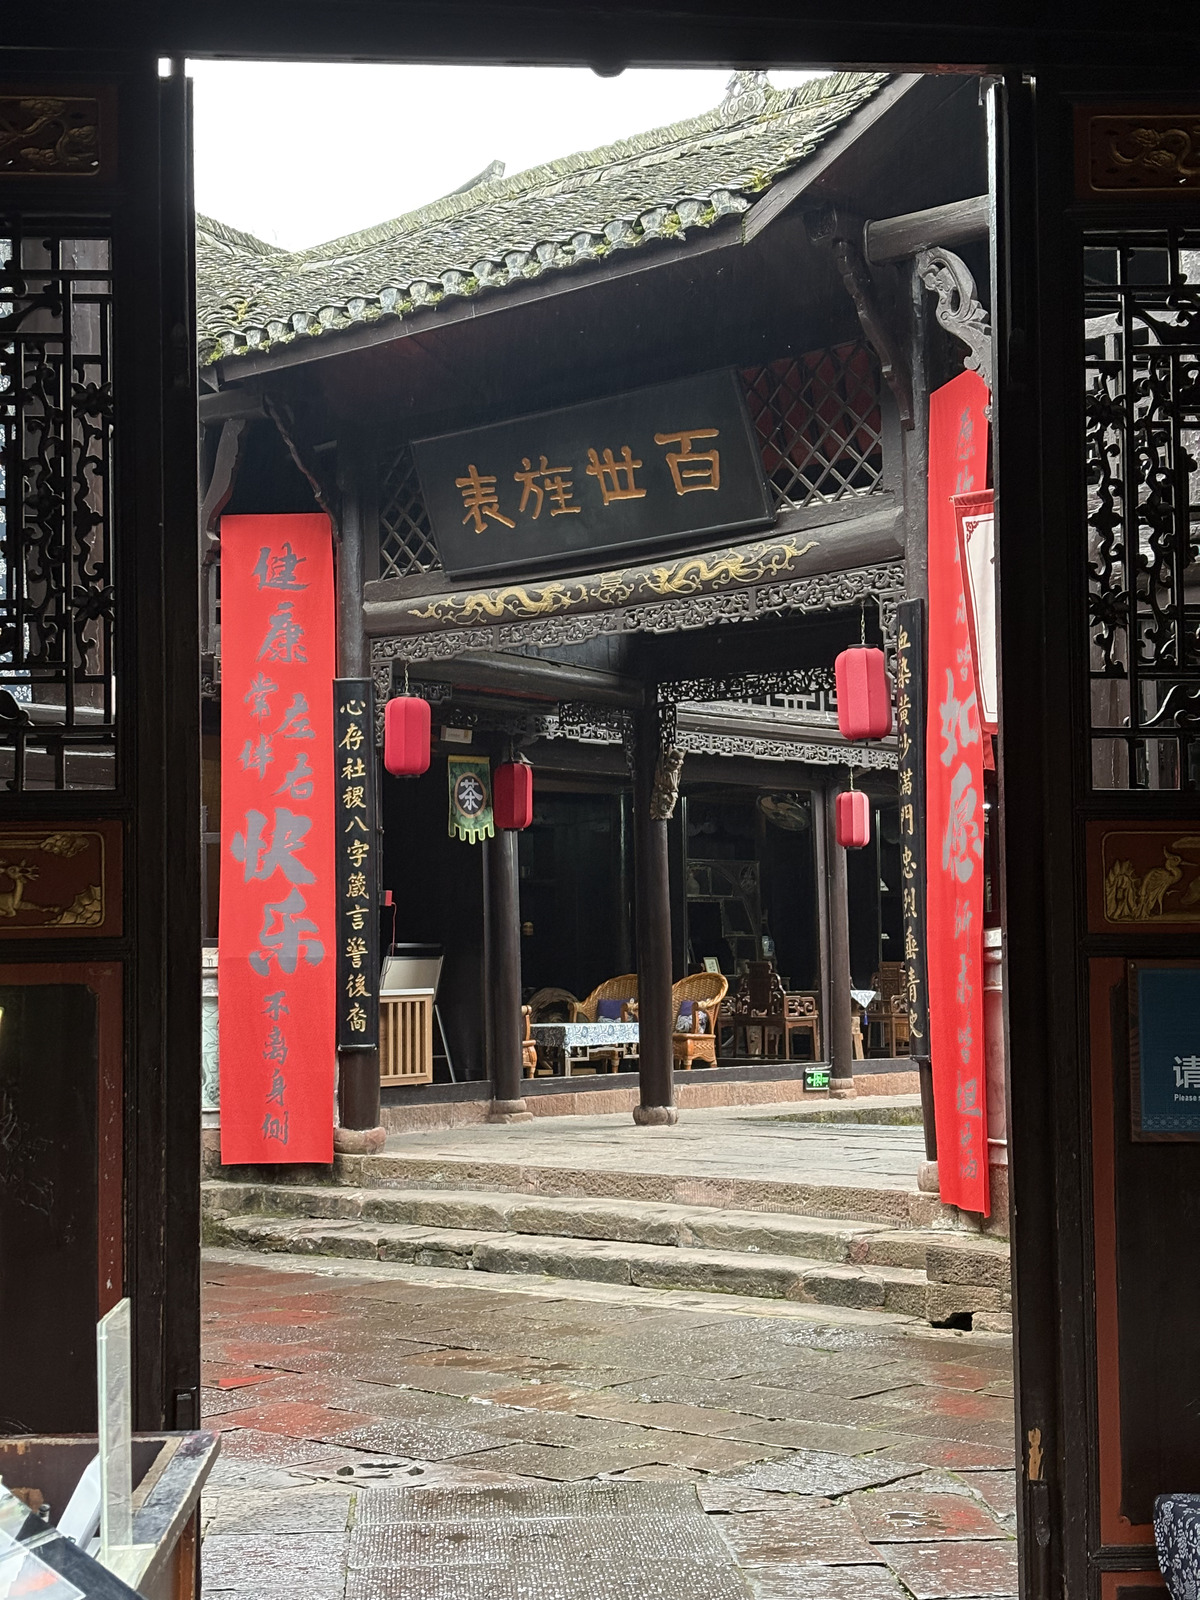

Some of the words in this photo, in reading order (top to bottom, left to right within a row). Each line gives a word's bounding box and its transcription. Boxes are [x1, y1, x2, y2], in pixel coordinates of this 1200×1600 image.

[458, 778, 483, 811] 茶
[1172, 1055, 1200, 1089] 请
[1174, 1093, 1197, 1102] Please
